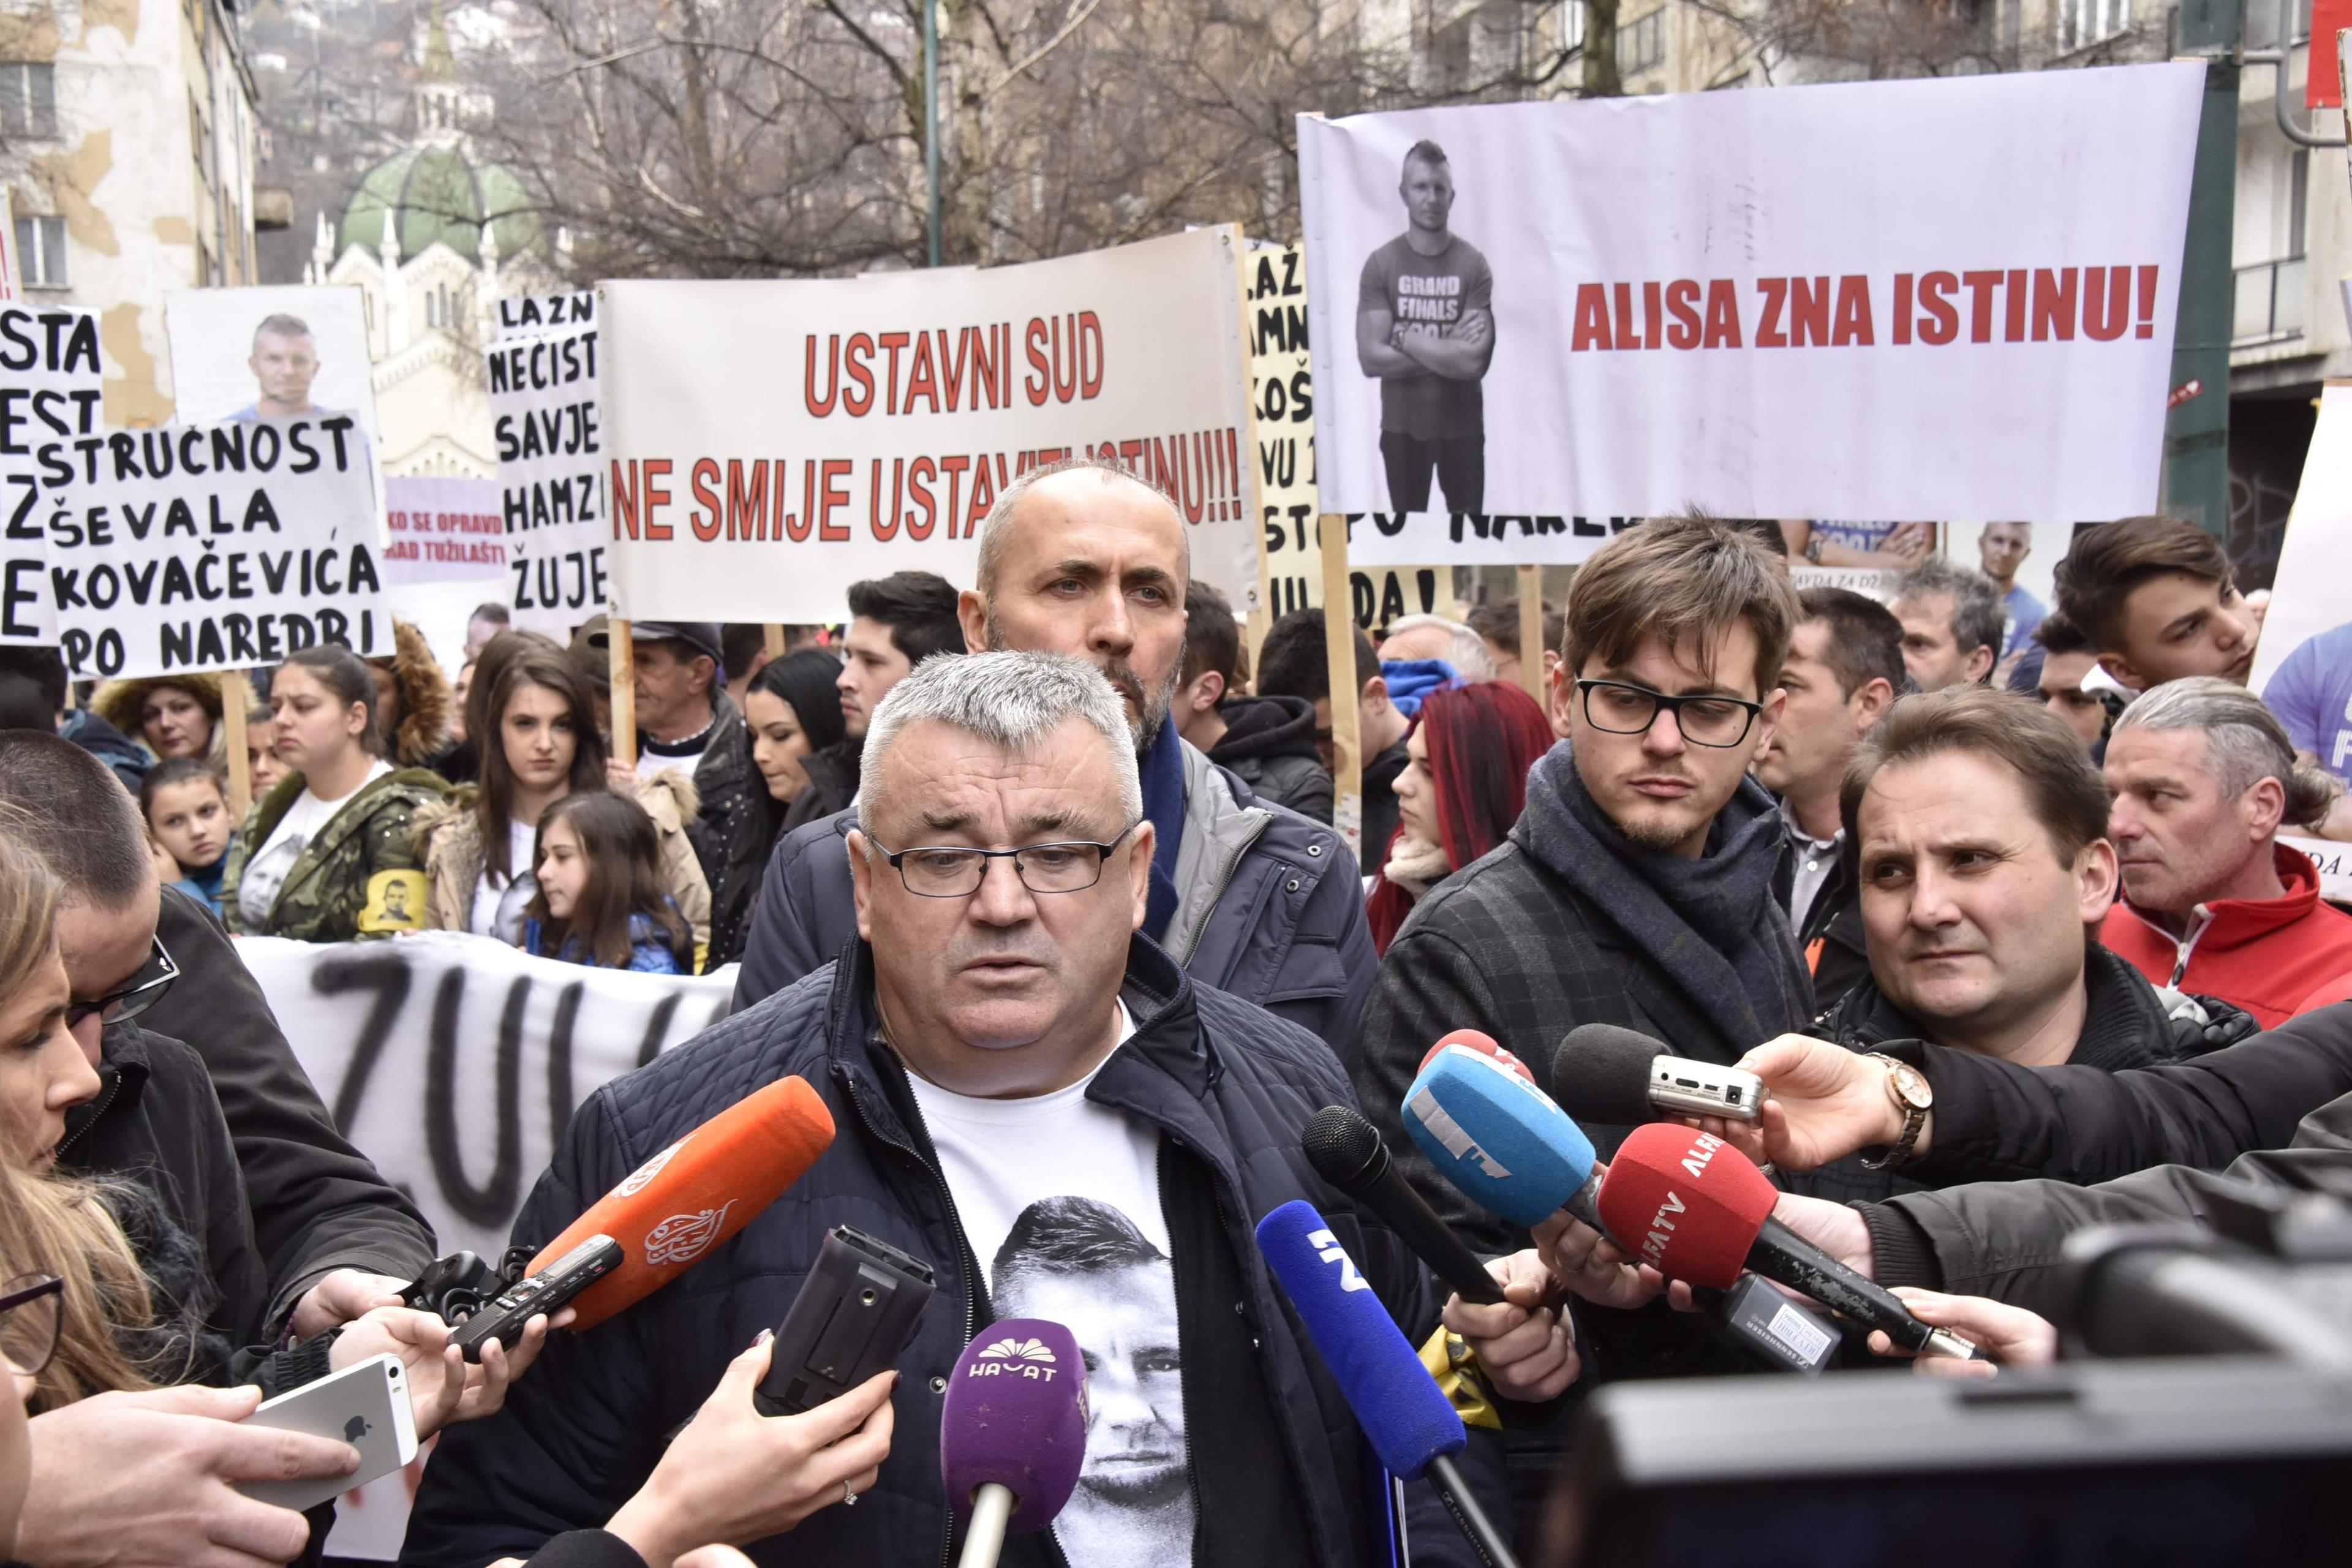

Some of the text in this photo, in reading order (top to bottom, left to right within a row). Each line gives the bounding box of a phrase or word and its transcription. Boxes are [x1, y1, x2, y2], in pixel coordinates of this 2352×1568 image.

[1397, 296, 1458, 321] FINALS
[1398, 275, 1460, 296] GRAND
[1571, 265, 2159, 351] ALISA ZNA ISTINU!
[0, 309, 100, 373] STA
[805, 310, 1104, 418] USTAVNI SUD
[0, 390, 100, 454] EST
[37, 417, 353, 488] STRUČNOST
[495, 401, 599, 462] SAVJE
[50, 488, 281, 547] ŠEVALA
[412, 512, 432, 533] SE
[612, 459, 673, 540] NE
[690, 458, 853, 542] SMIJE
[1264, 504, 1321, 553] ST
[51, 527, 380, 611] KOVAČEVIĆA
[512, 543, 607, 609] ŽUJE
[61, 608, 373, 676] PO NAREDBI
[1746, 1320, 1798, 1360] SENNHEISER
